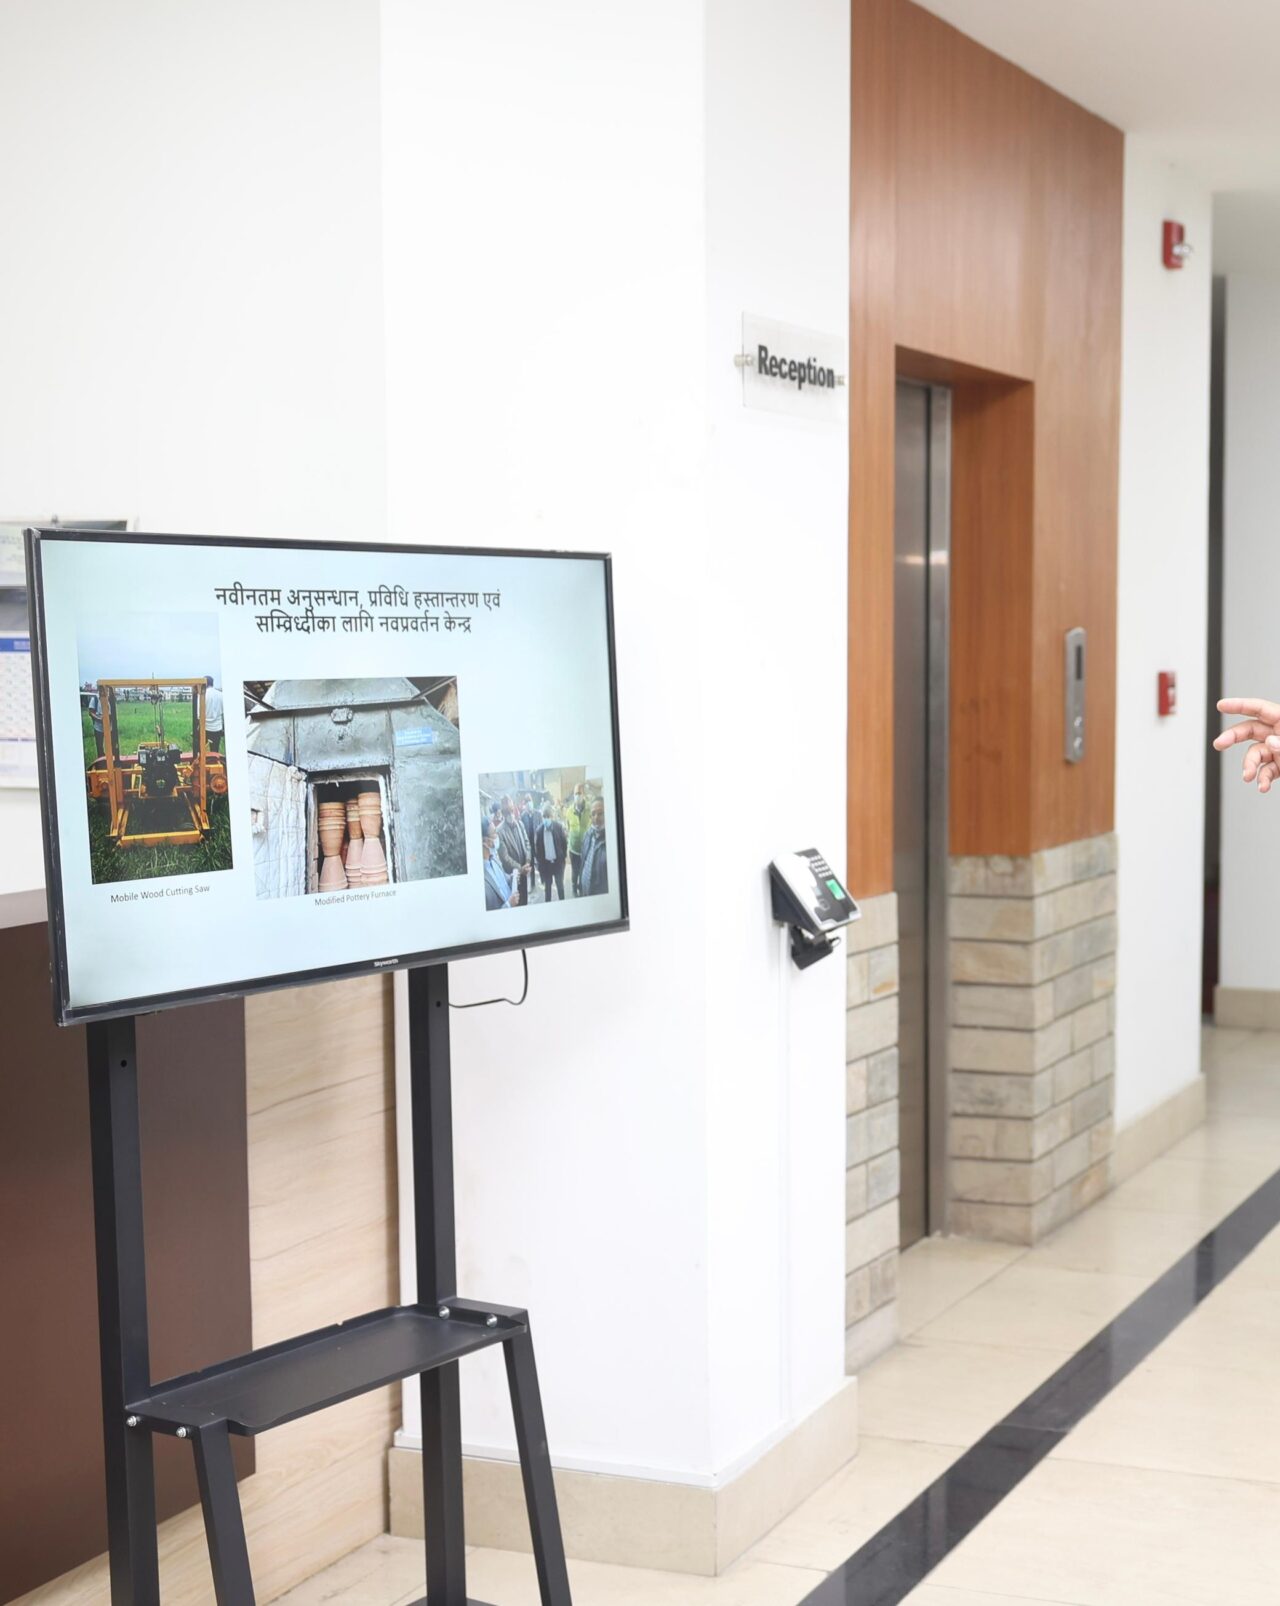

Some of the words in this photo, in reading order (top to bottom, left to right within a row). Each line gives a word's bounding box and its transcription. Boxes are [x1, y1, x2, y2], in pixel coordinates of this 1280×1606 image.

[758, 344, 835, 390] Reception
[214, 581, 282, 605] नवीनतम
[368, 584, 409, 607] प्रविधि
[413, 591, 479, 609] हस्तान्तरण
[483, 588, 501, 611] एवं
[341, 610, 374, 632] लागि
[378, 609, 440, 632] नवप्रवर्तन
[443, 610, 472, 633] केन्द्र
[110, 892, 139, 903] Mobile
[140, 889, 164, 899] Wood
[166, 886, 194, 896] Cutting
[195, 884, 210, 893] Saw
[315, 894, 345, 906] Modified
[346, 892, 370, 902] Pottery
[371, 889, 396, 899] Furnace
